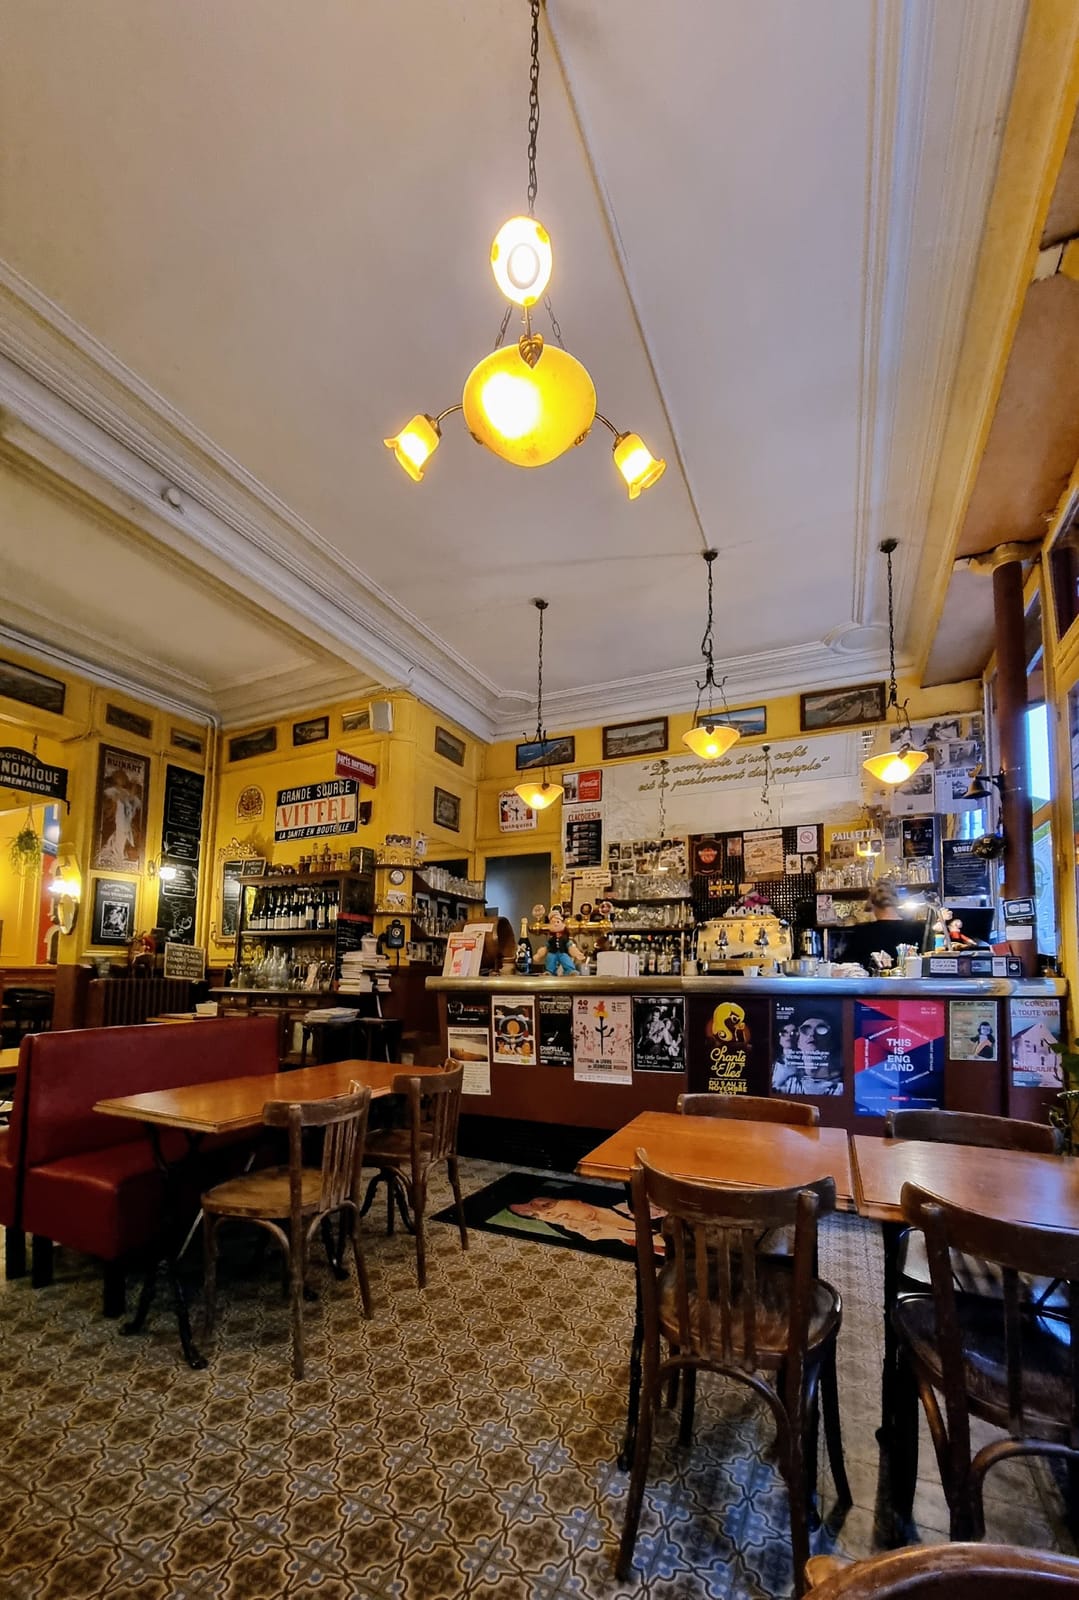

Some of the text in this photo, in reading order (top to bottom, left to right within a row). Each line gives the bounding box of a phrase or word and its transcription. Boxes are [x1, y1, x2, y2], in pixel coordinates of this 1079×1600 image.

[281, 780, 351, 804] GRANDE SOURCE
[281, 797, 351, 829] VITTEL
[279, 830, 287, 840] LA
[306, 826, 315, 836] EN
[316, 822, 351, 835] BOUTELLE
[577, 999, 589, 1007] 40
[1024, 1000, 1059, 1008] CONCERT
[1018, 1009, 1041, 1017] TOUTE
[886, 1038, 912, 1047] THIS
[710, 1045, 747, 1062] Chants
[894, 1047, 904, 1055] IS
[887, 1055, 911, 1064] ENG
[884, 1063, 915, 1073] LAND
